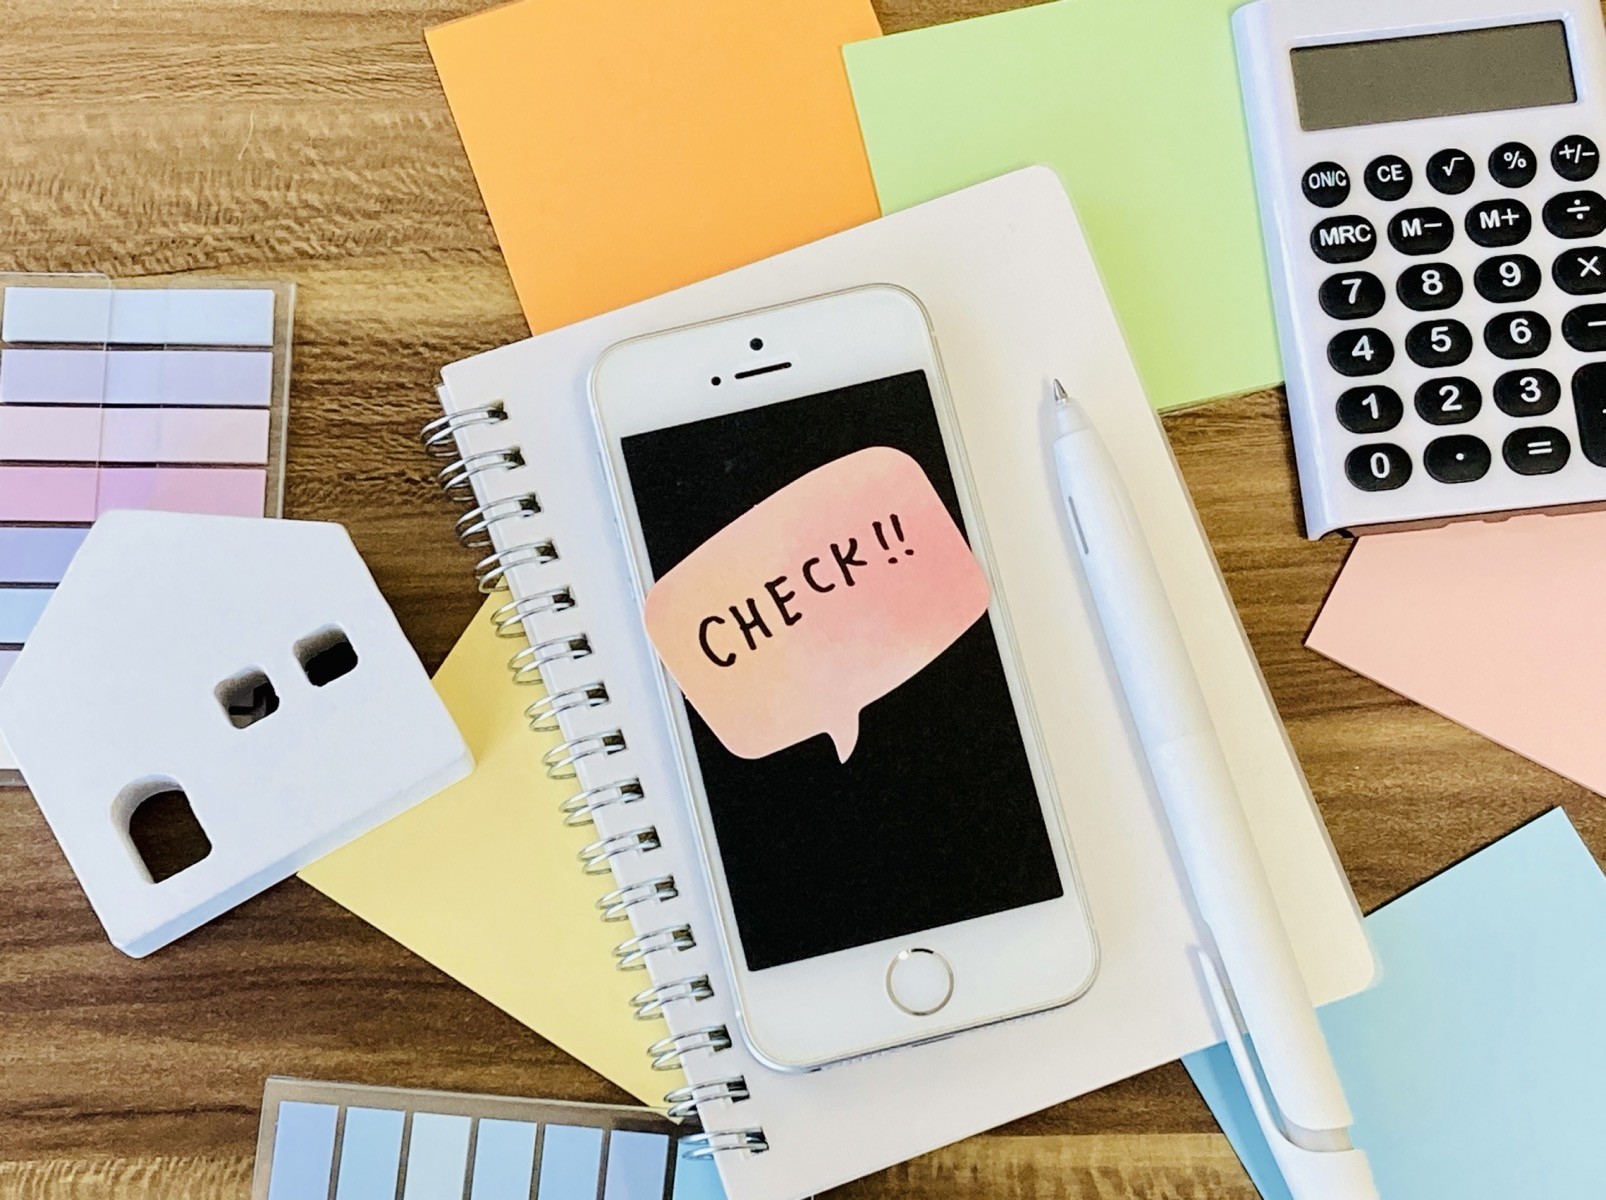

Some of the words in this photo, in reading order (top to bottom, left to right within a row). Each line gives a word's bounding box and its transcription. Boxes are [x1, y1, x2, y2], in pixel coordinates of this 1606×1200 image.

[1504, 151, 1526, 168] %
[1308, 170, 1347, 189] ON/C
[1377, 165, 1404, 182] CE
[1480, 209, 1519, 228] M+
[1319, 223, 1372, 246] MRC
[1422, 270, 1443, 295] 8
[1500, 262, 1521, 286] 9
[1342, 279, 1361, 303] 7
[1431, 327, 1451, 352] 5
[1510, 319, 1531, 343] 6
[1352, 336, 1374, 360] 4
[1439, 385, 1462, 411] 2
[1520, 377, 1541, 402] 3
[1362, 393, 1378, 419] 1
[1371, 453, 1390, 478] 0
[699, 514, 914, 667] CHECK!!
